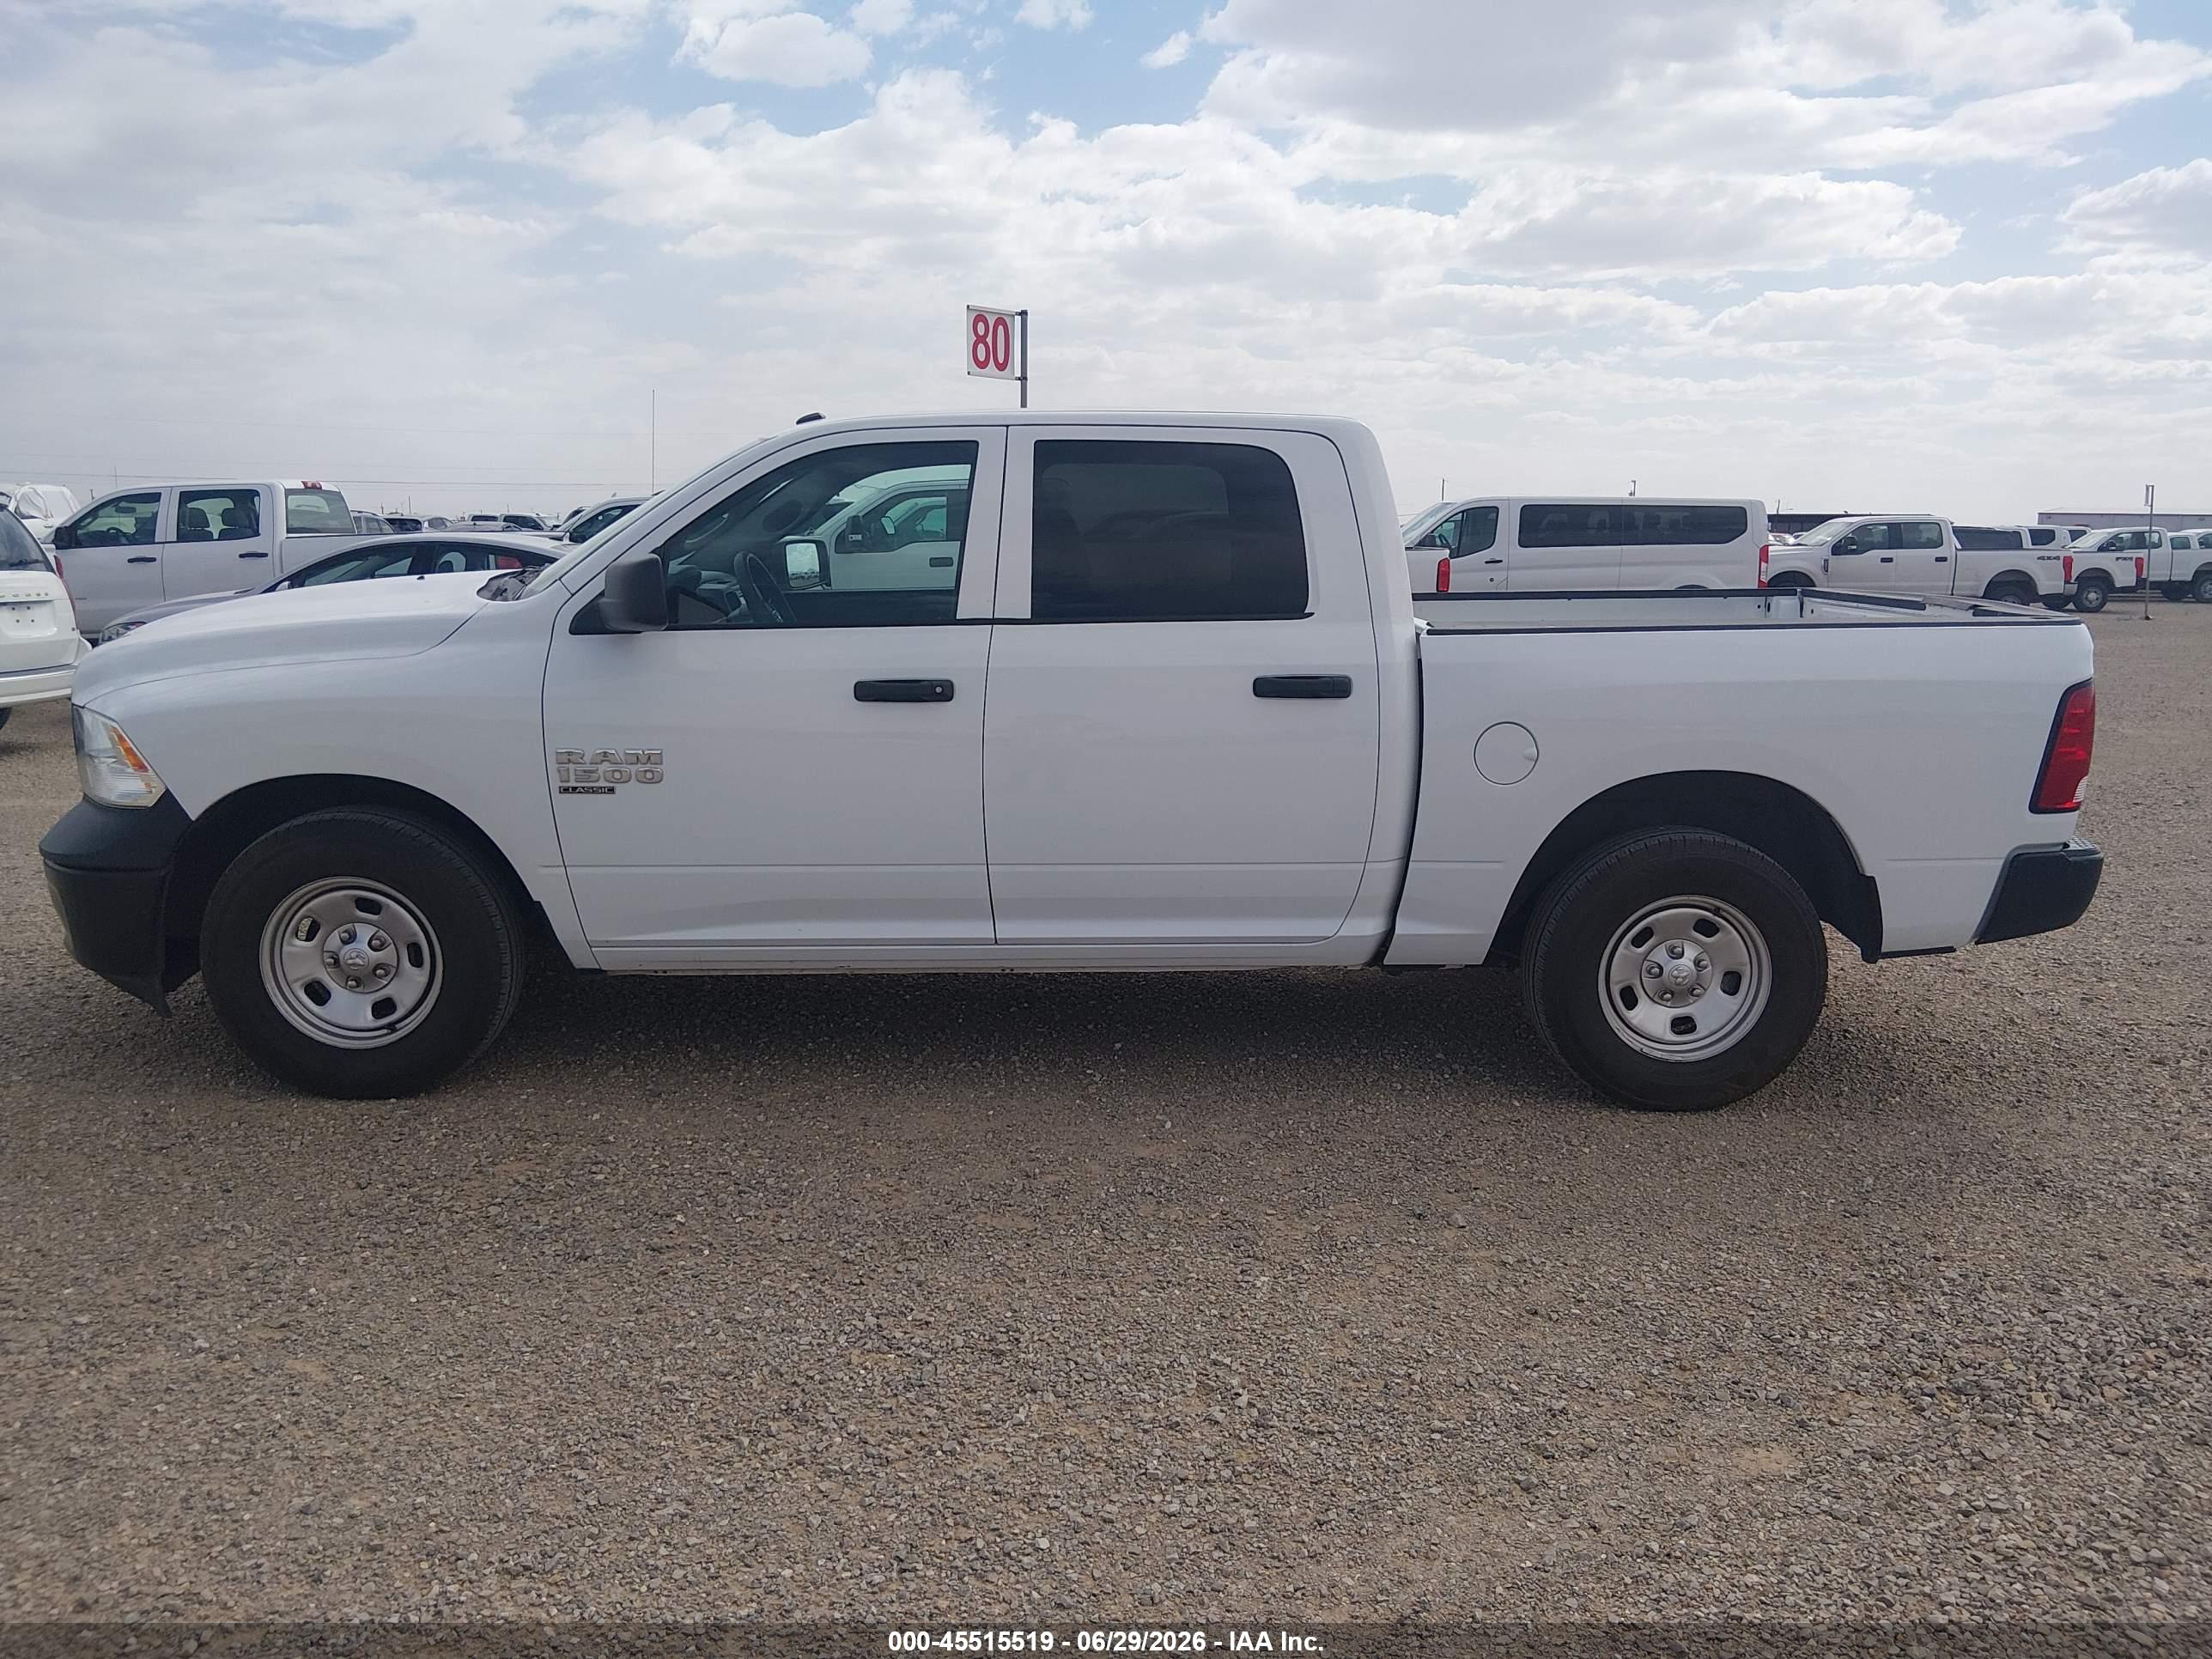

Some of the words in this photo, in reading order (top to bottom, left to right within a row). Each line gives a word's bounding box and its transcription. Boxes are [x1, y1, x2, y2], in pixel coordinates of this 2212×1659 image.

[972, 313, 1010, 372] 80
[556, 748, 663, 765] RAM
[556, 766, 664, 784] 1500
[560, 786, 615, 794] CLASSIC
